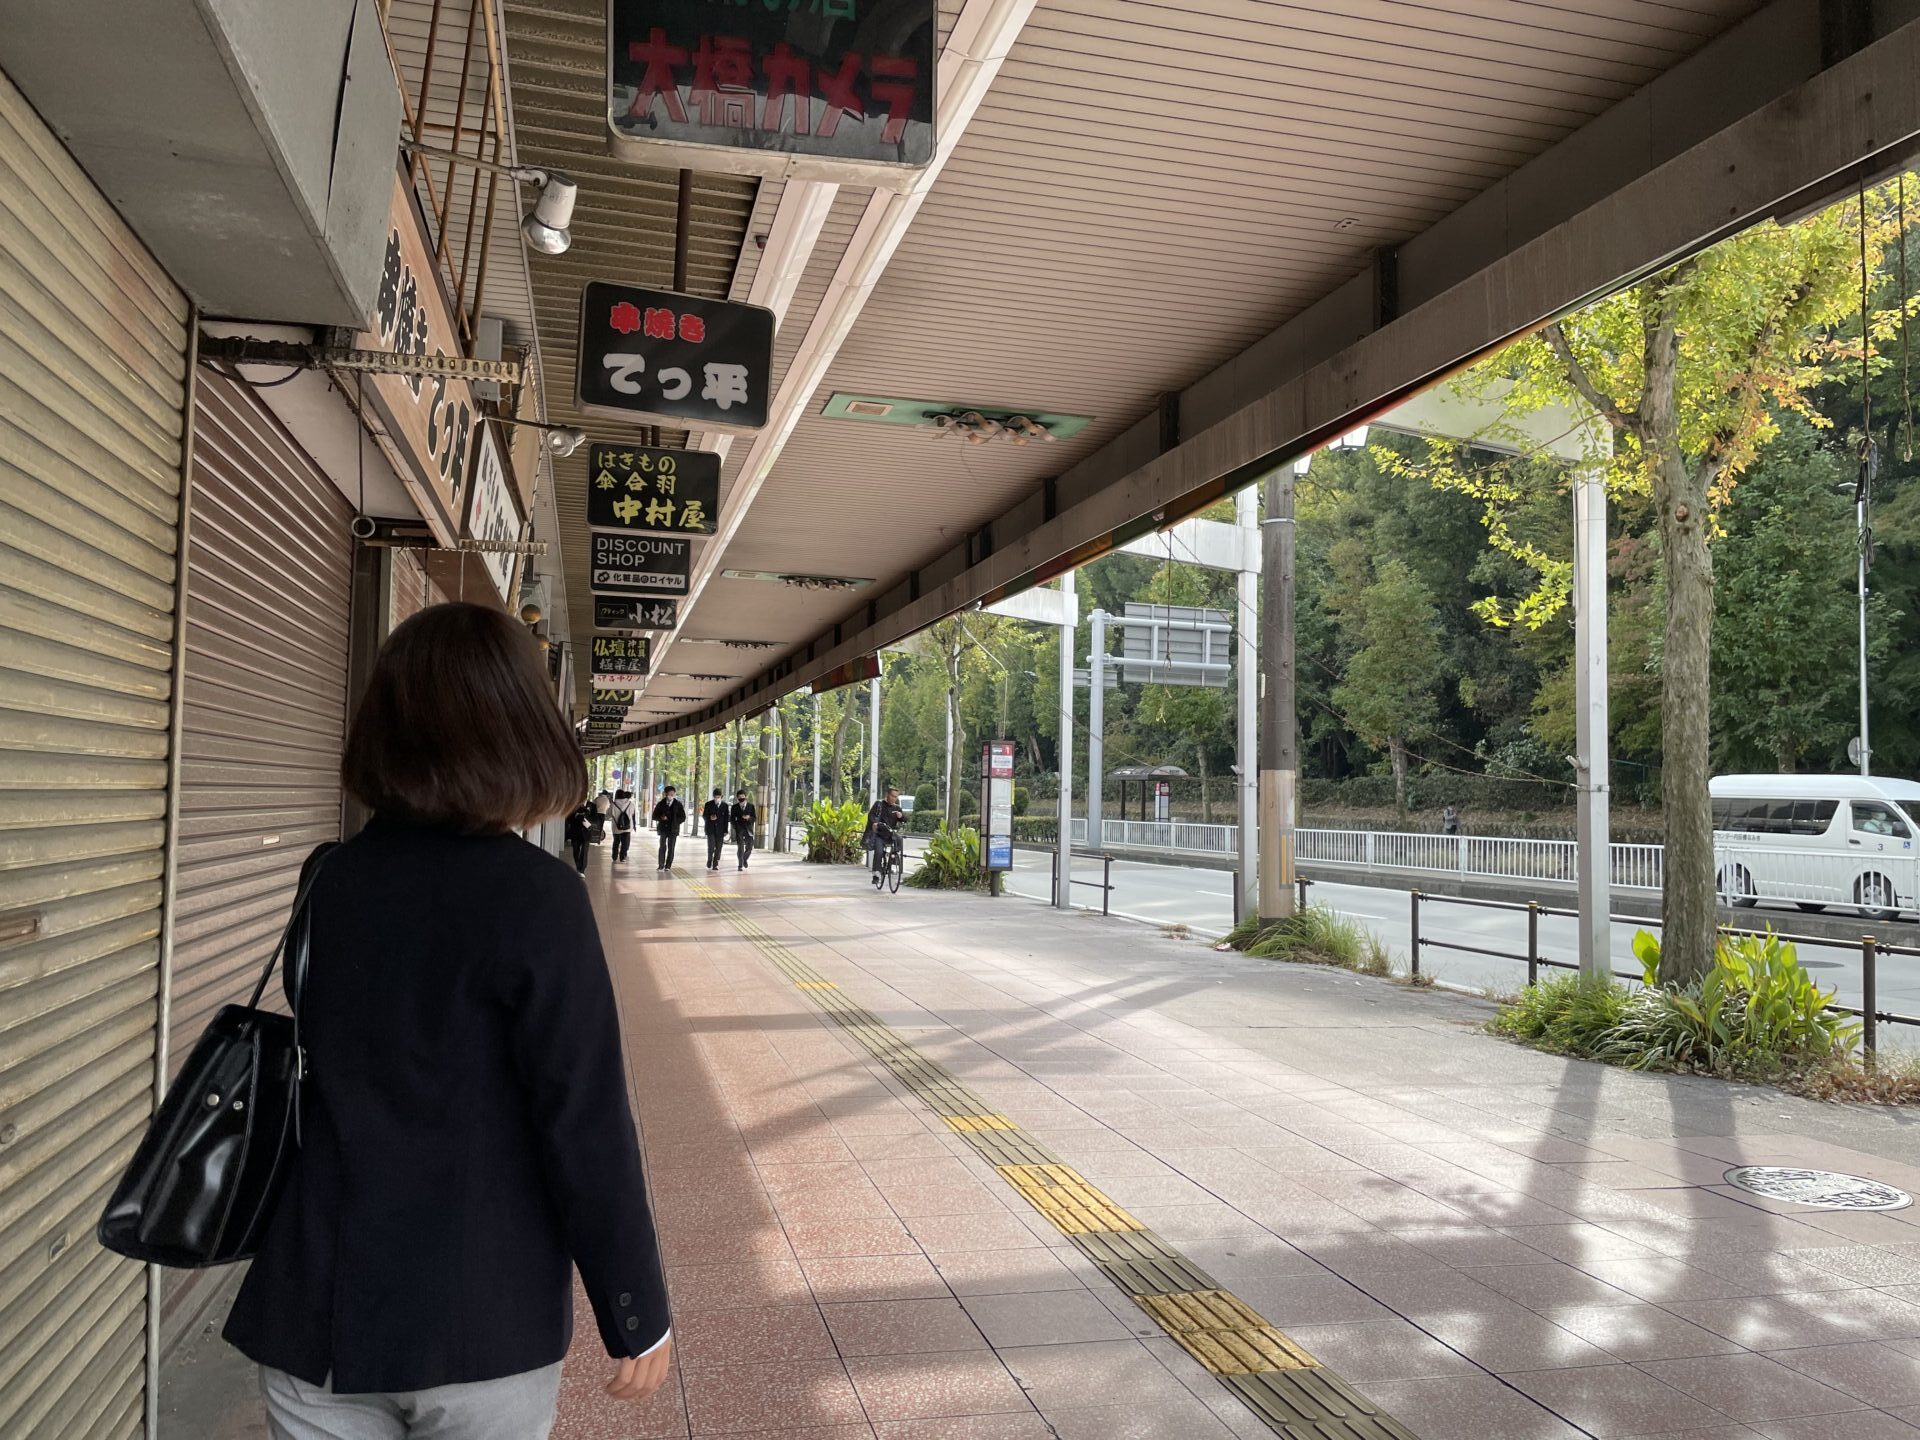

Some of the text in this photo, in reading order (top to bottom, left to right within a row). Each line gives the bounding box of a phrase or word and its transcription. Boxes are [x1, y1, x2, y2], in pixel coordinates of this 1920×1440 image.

[629, 27, 918, 144] 大橋カメラ
[610, 302, 706, 343] 串焼き
[602, 352, 749, 410] てっ平
[598, 451, 676, 474] はきもの
[595, 469, 676, 495] 傘合羽
[612, 493, 706, 529] 中村屋
[596, 537, 685, 556] DISCOUNT
[596, 551, 645, 567] SHOP
[628, 602, 673, 626] 小松
[593, 638, 626, 658] 仏壇
[1877, 843, 1884, 851] 3
